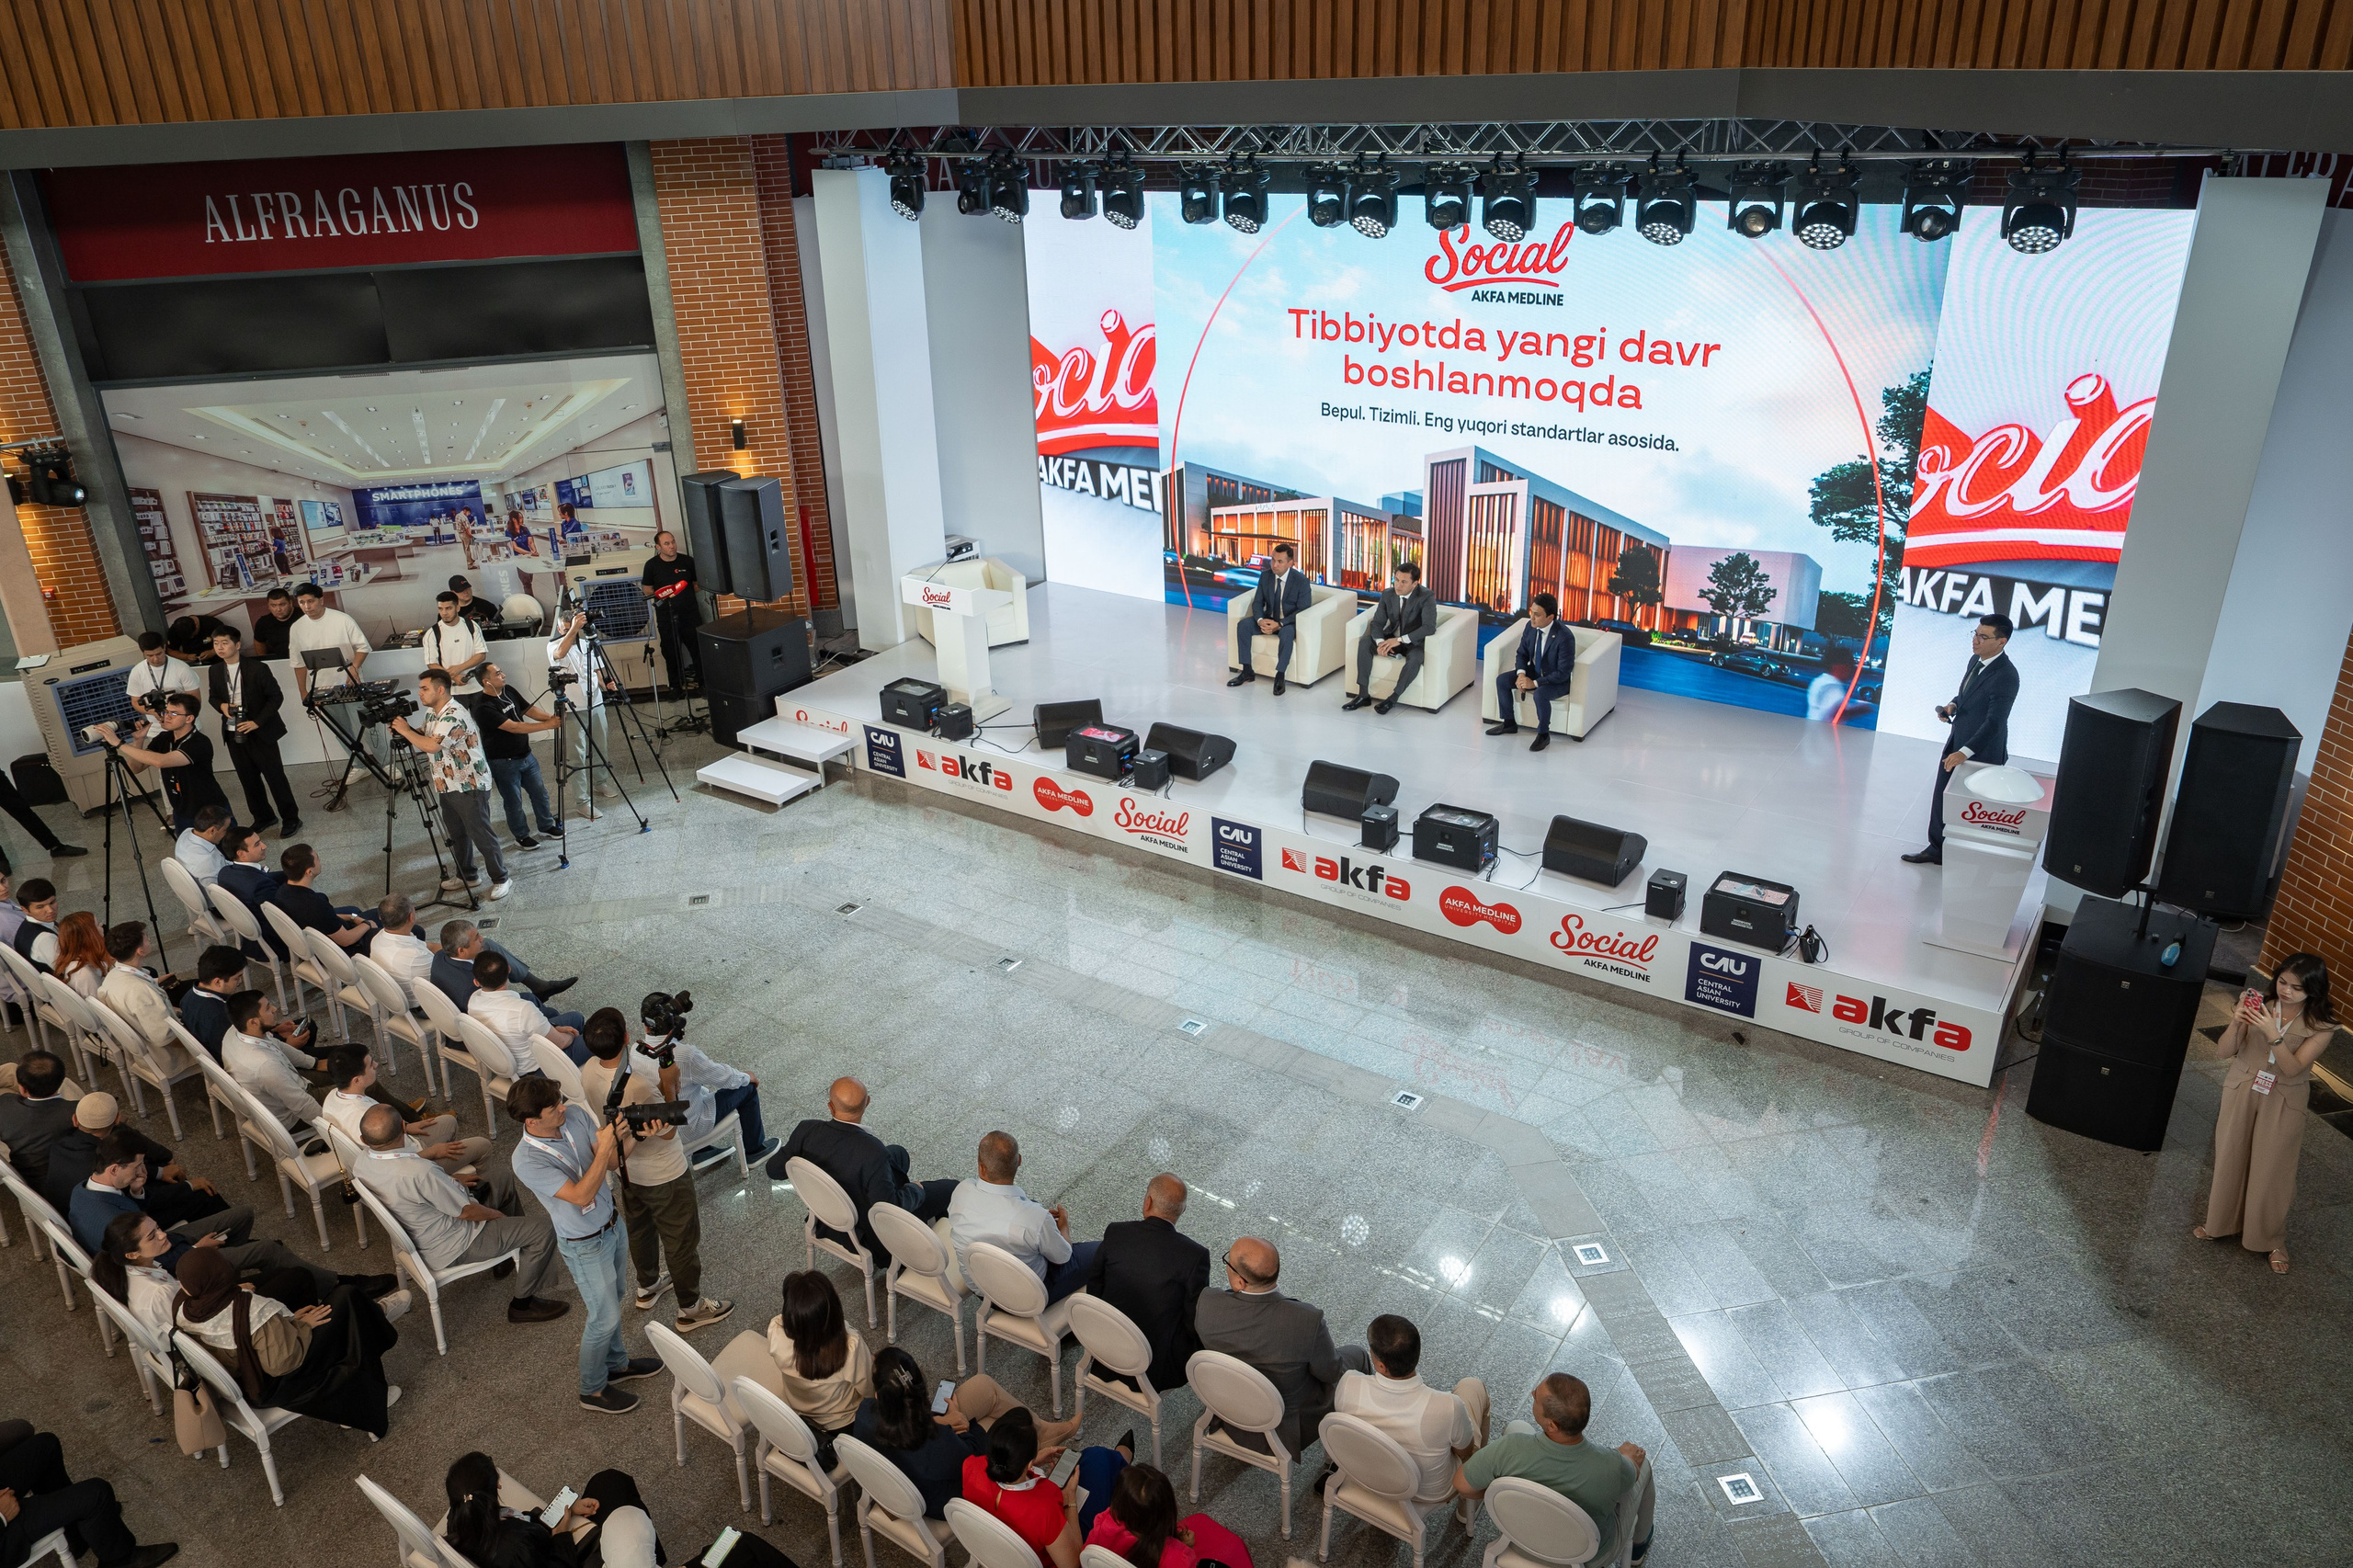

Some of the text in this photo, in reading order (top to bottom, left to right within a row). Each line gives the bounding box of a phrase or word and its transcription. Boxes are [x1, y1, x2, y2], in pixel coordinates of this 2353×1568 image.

[205, 182, 479, 243] ALFRAGANUS
[1425, 222, 1574, 285] Social
[1471, 290, 1564, 306] AKFA MEDLINE
[1288, 308, 1722, 368] Tibbiyotda yangi davr
[1344, 354, 1643, 413] boshlanmoqda
[1321, 402, 1680, 452] Bepul. Tizimli. Eng yuqori standartlar asosida.
[372, 486, 463, 502] SMARTPHONES
[923, 586, 951, 603] Social
[870, 732, 894, 747] CAU
[873, 751, 892, 761] CENTRAL
[874, 762, 898, 772] UNIVERSITY
[941, 755, 1013, 791] akfa
[949, 779, 967, 789] GROUP
[976, 787, 1008, 800] COMPANIES
[1037, 787, 1089, 807] AKFA MEDLINE
[1114, 797, 1189, 836] Social
[1961, 801, 2027, 825] Social
[1140, 835, 1188, 854] AKFA MEDLINE
[1220, 825, 1252, 845] CAU
[1220, 847, 1245, 860] CENTRAL
[1221, 854, 1238, 863] ASIAN
[1221, 859, 1253, 873] UNIVERSITY
[1314, 856, 1411, 902] akfa
[1320, 883, 1402, 912] GROUP OF COMPANIES
[1444, 903, 1516, 927] UNIVERSITY HOSPITAL
[1445, 897, 1517, 923] AKFA MEDLINE
[1550, 914, 1659, 962] Social
[1584, 958, 1651, 983] AKFA MEDLINE
[1700, 952, 1746, 976] CAU
[1697, 985, 1722, 996] ASIAN
[1698, 978, 1733, 993] CENTRAL
[1696, 992, 1741, 1008] UNIVERSITY
[1832, 994, 1972, 1051] akfa
[1838, 1027, 1955, 1062] GROUP OF COMPANIES
[2255, 1077, 2272, 1088] PRESS
